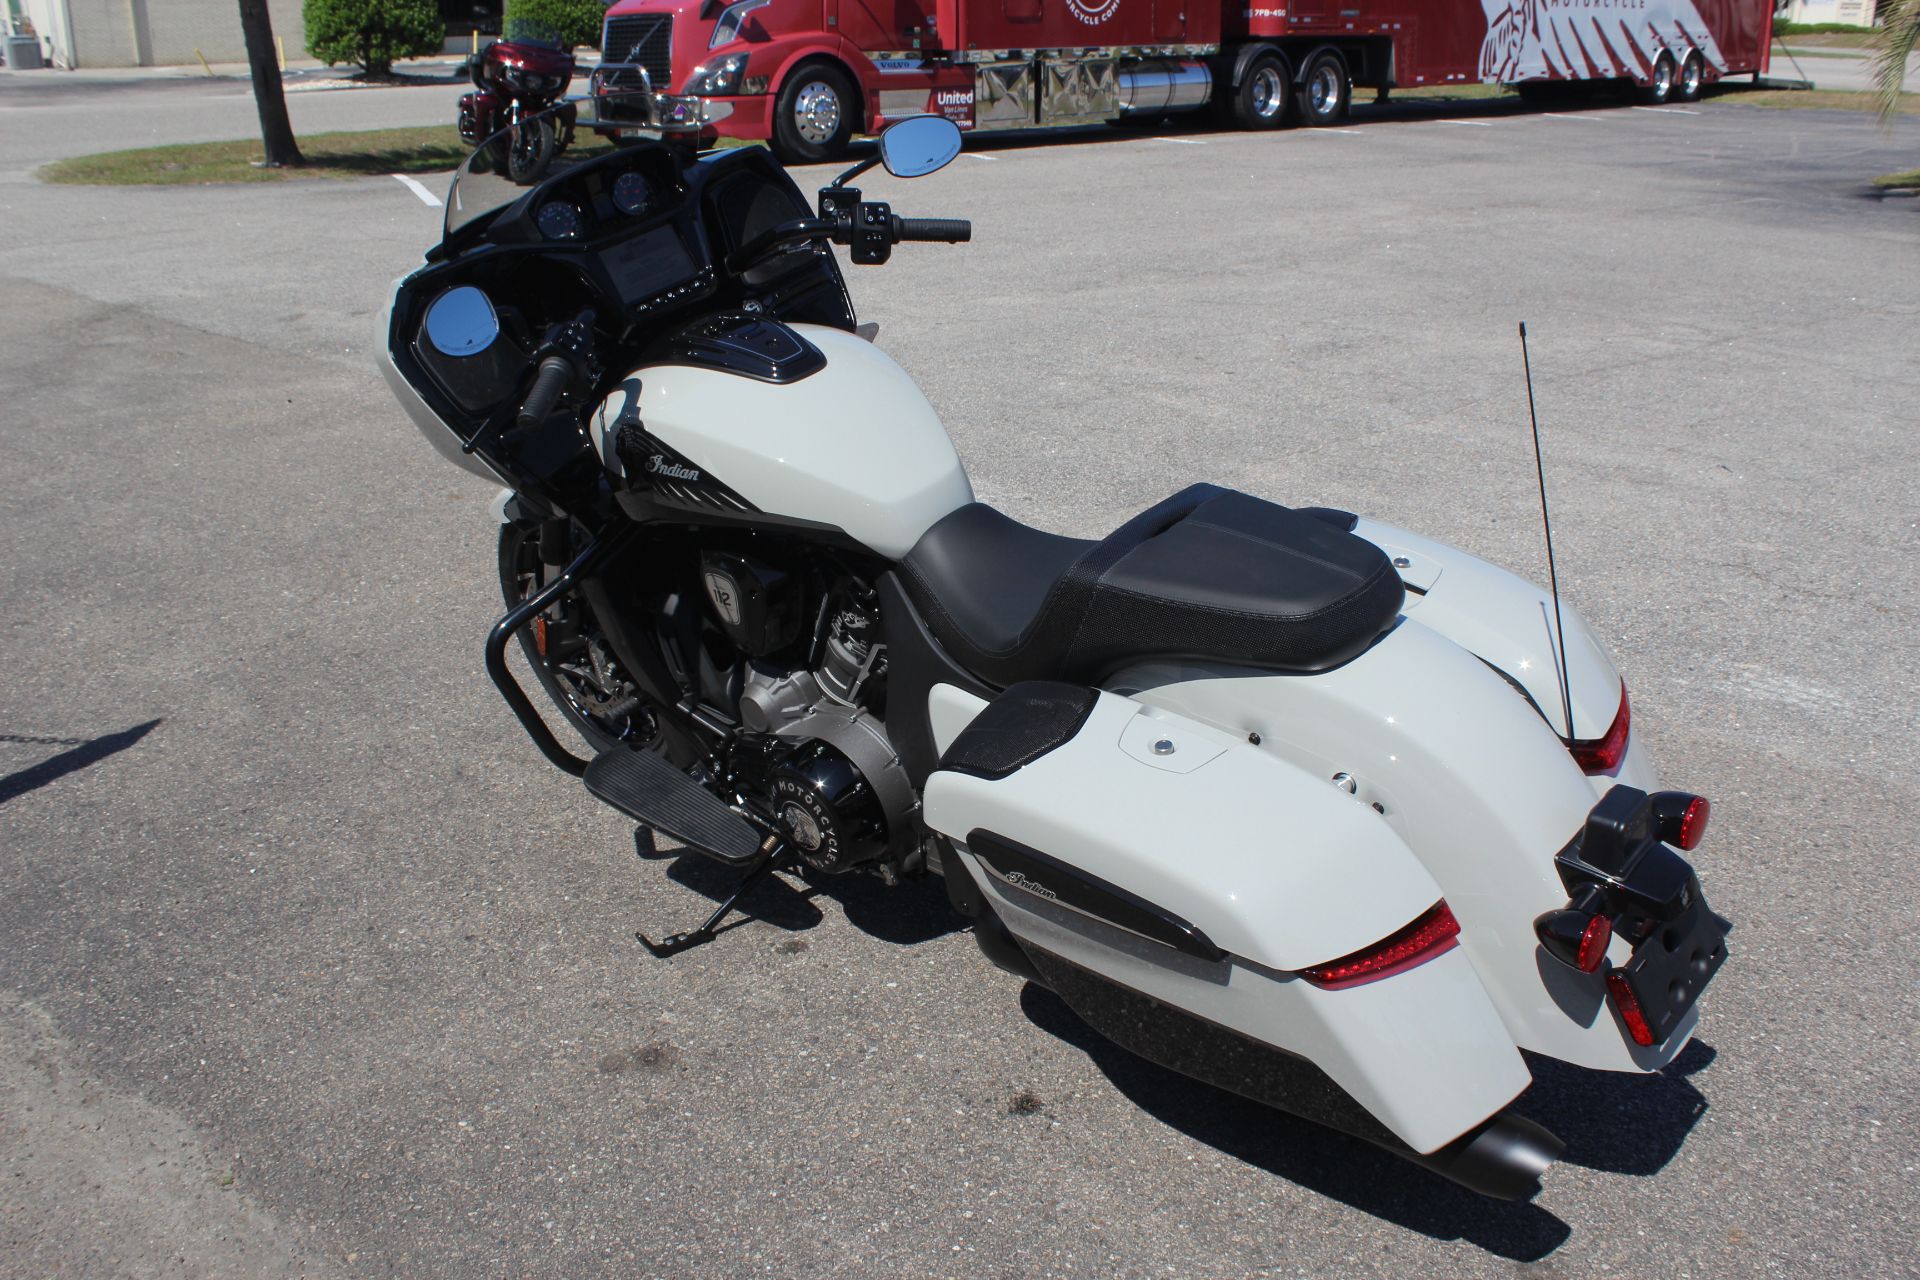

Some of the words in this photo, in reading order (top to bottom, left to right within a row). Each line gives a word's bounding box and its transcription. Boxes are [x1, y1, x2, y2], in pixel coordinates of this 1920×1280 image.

[880, 61, 910, 69] VOLVO
[938, 90, 974, 104] United
[645, 454, 700, 481] Indian
[713, 589, 731, 607] 112
[779, 780, 838, 862] MOTORCYCLE
[1006, 871, 1057, 899] Indian
